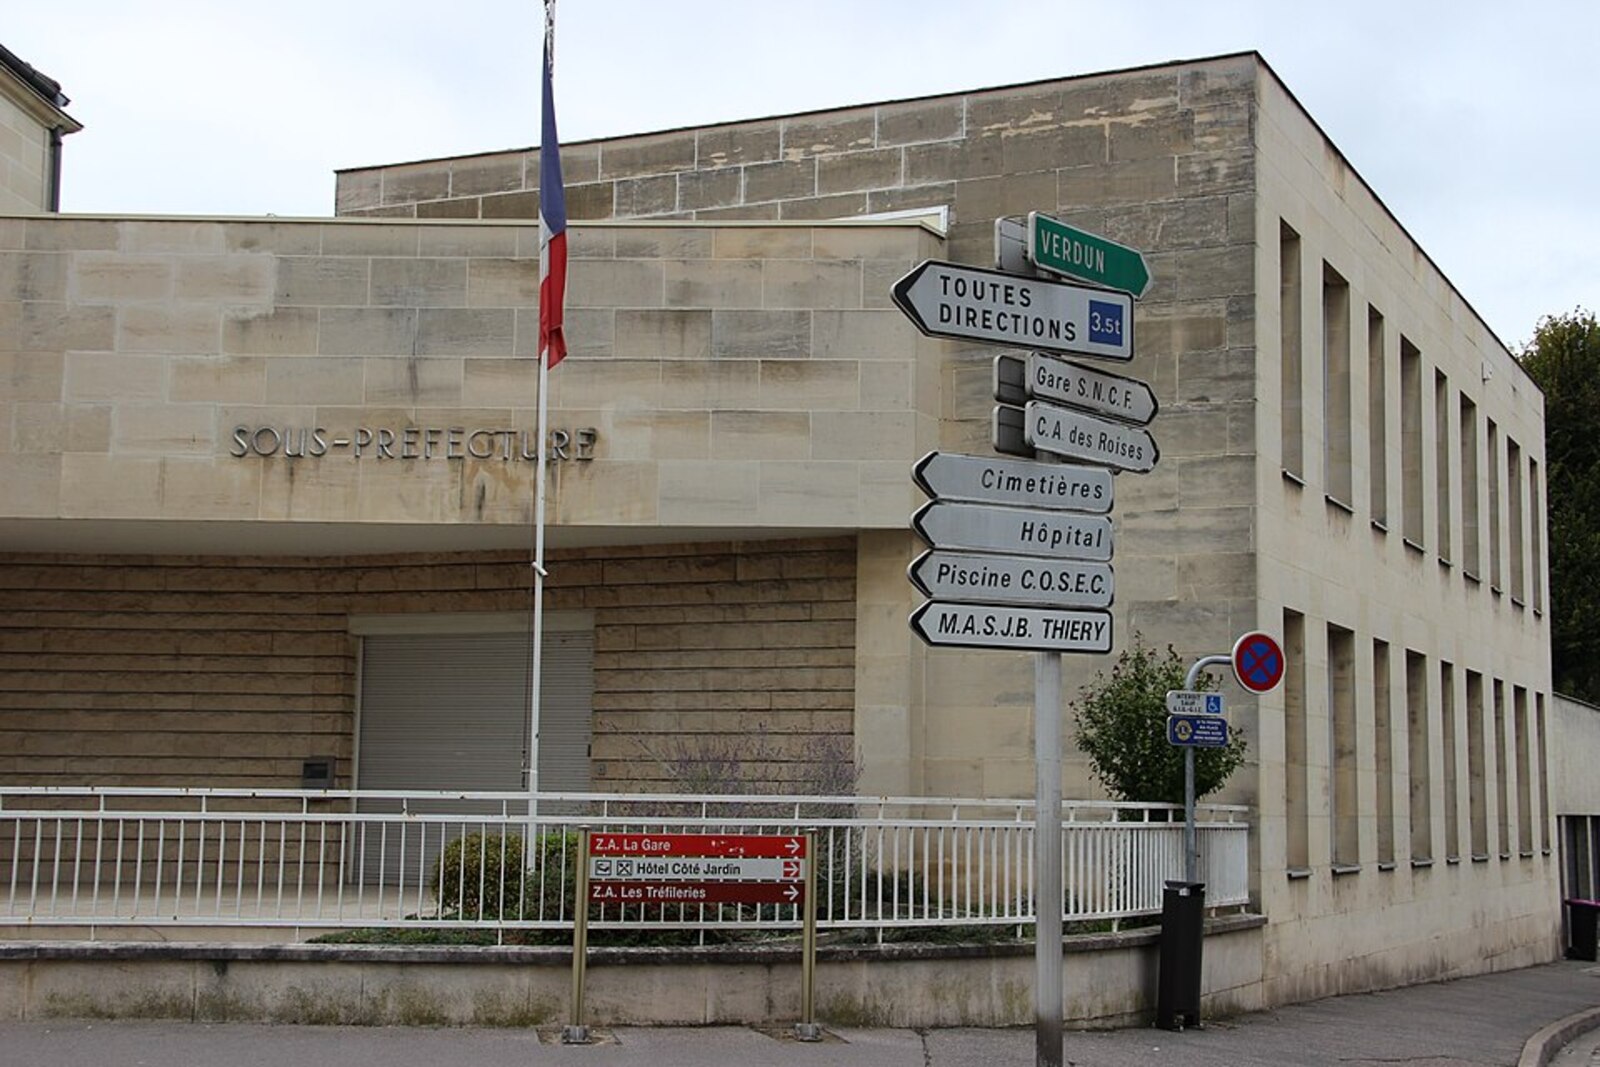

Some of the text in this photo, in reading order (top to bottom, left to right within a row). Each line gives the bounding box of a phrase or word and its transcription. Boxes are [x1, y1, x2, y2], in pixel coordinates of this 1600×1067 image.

[1040, 228, 1105, 275] VERDUN
[939, 275, 1032, 308] TOUTES
[939, 303, 1076, 342] DIRECTIONS
[1091, 312, 1121, 335] 3.5t
[1036, 366, 1133, 410] Gare S.N.C.F.
[229, 427, 598, 461] SOUS-PREFECTURE
[1069, 425, 1093, 449] des
[1098, 432, 1144, 461] Roises
[981, 468, 1104, 500] Cimetières
[1020, 521, 1103, 549] Hôpital
[936, 563, 1106, 595] Piscine C.O.S.E.C.
[937, 612, 1106, 642] M.A.S.J.B. THIERY
[595, 838, 671, 851] Z.A. La Gare
[636, 860, 741, 876] Hôtel Côté Jardin
[592, 886, 707, 899] Z.A. Les Tréfileries
